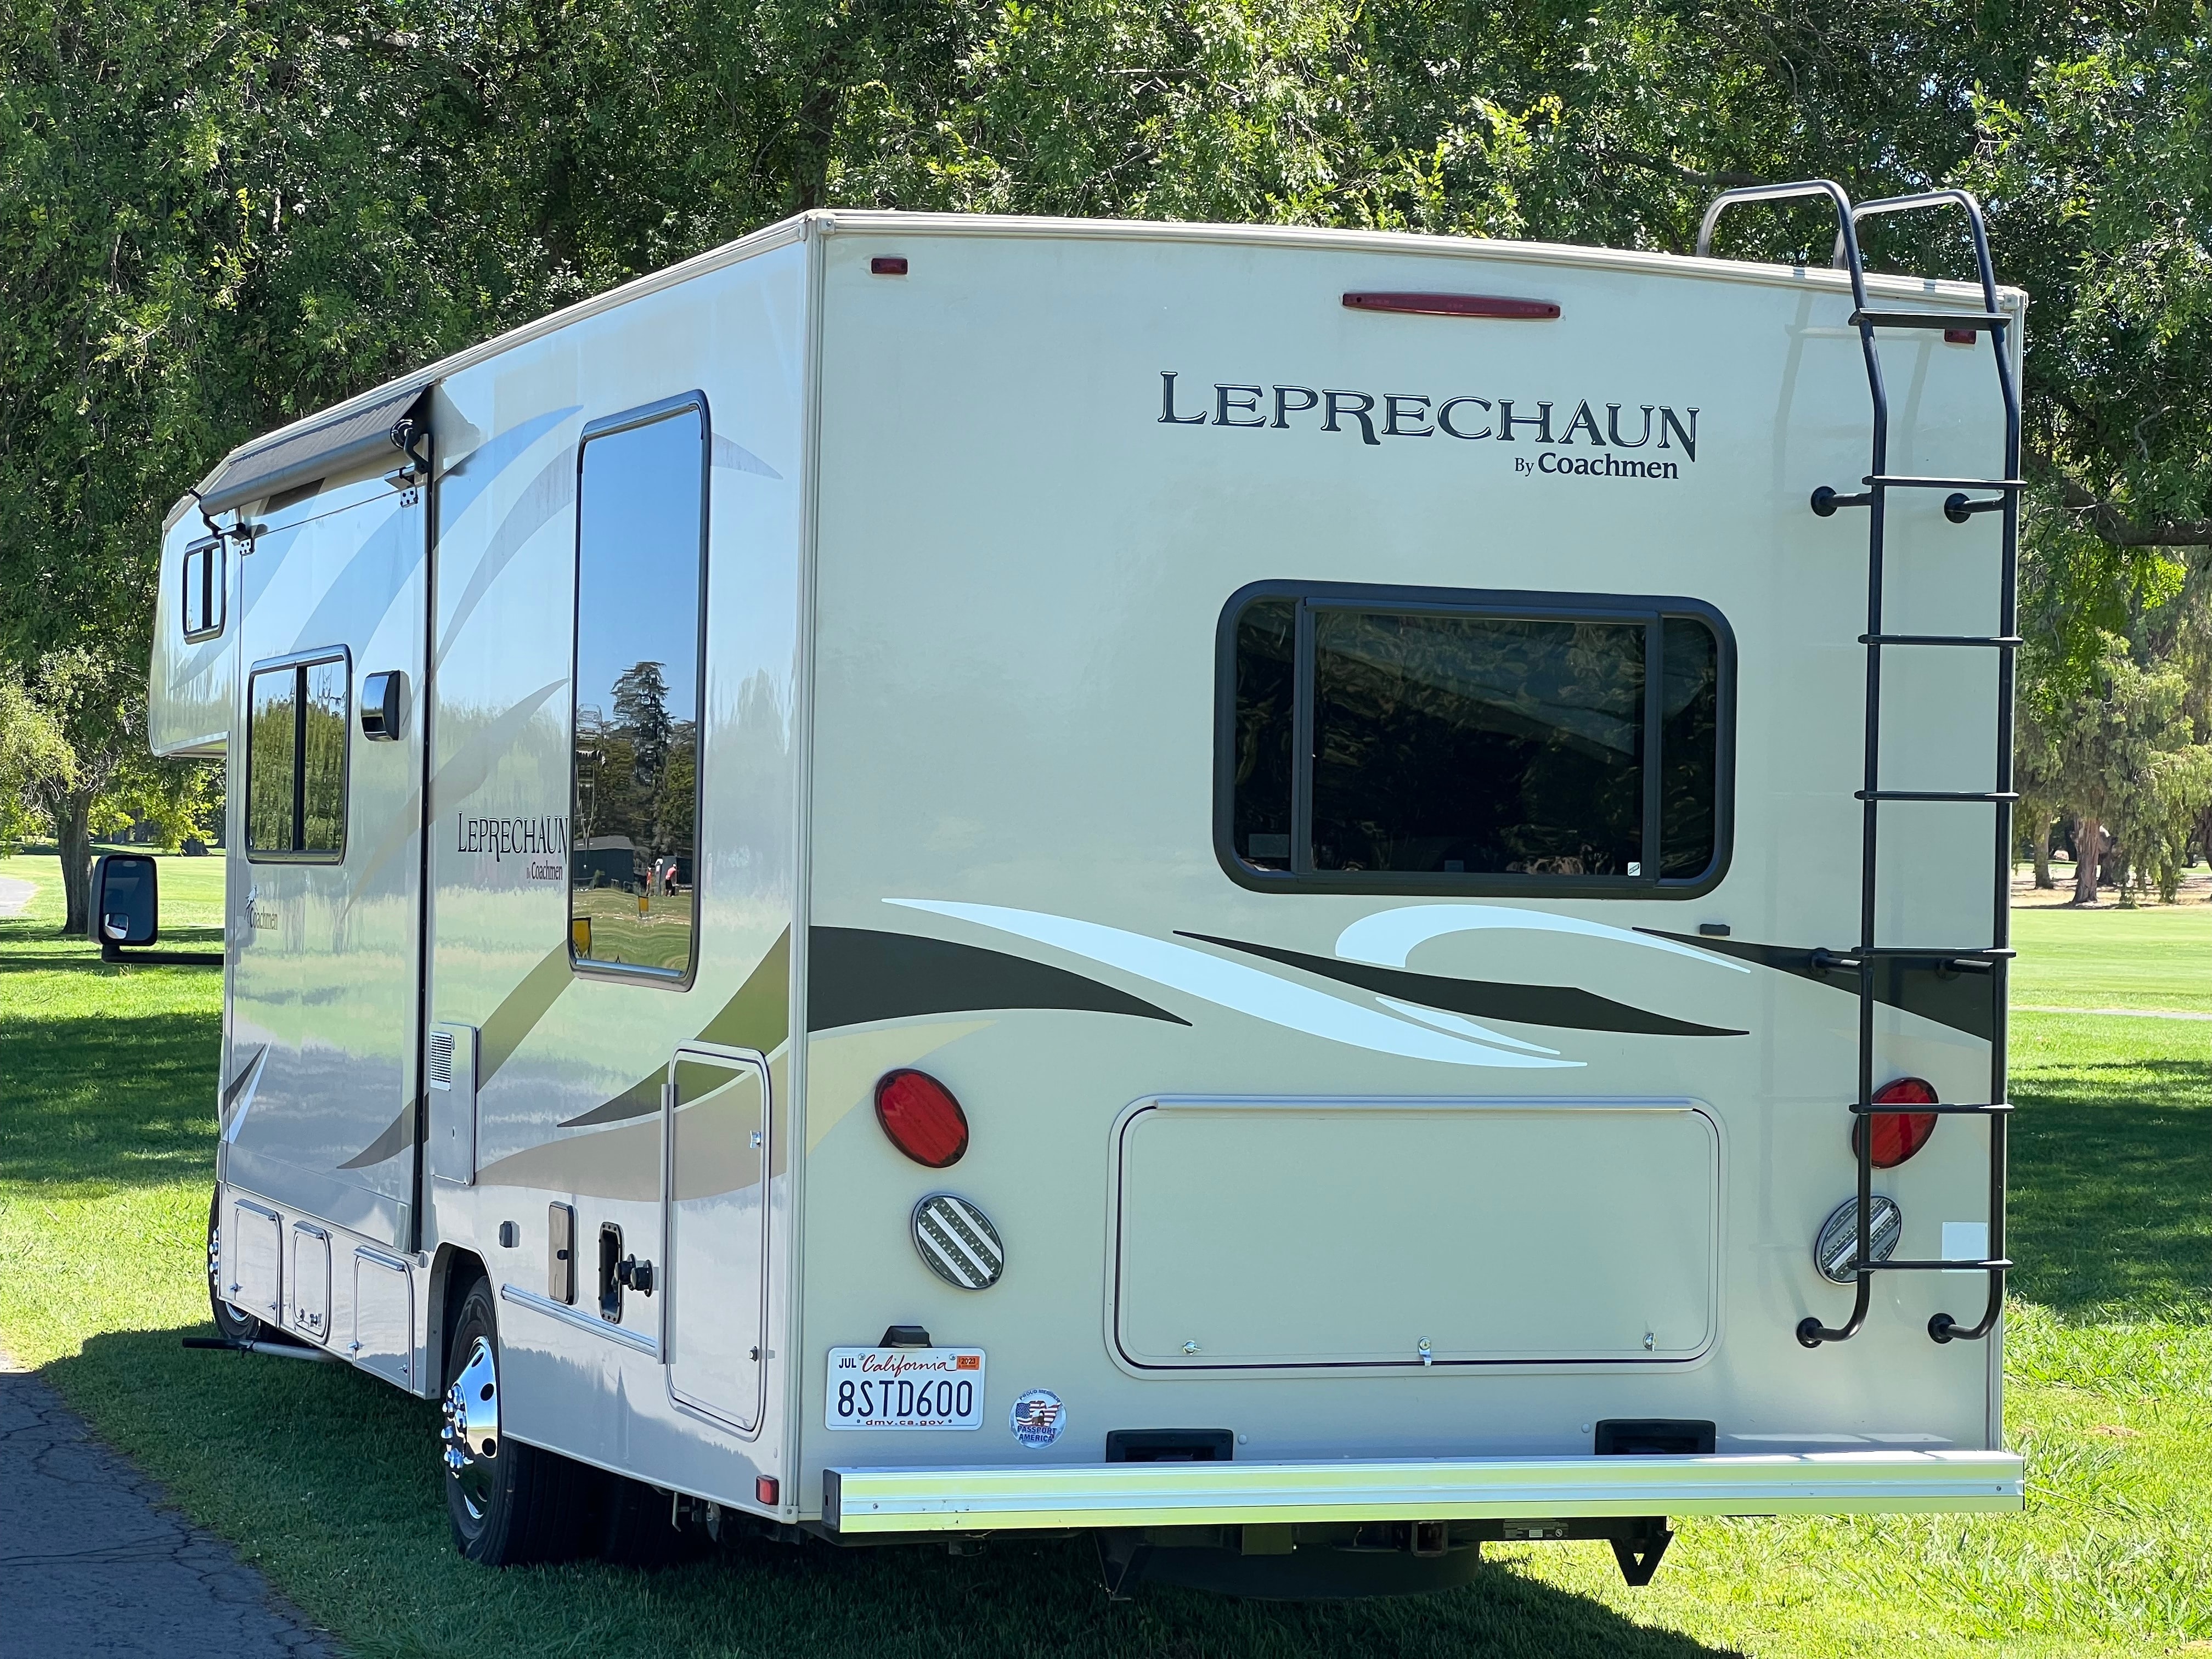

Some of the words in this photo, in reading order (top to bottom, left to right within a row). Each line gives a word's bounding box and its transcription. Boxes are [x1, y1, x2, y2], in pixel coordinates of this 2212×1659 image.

[1157, 370, 1700, 464] LEPRECHAUN
[1515, 457, 1534, 477] By
[1538, 452, 1679, 479] Coachmen
[458, 810, 569, 865] LEPRECHAUN
[531, 860, 563, 881] Coachmen
[249, 906, 278, 930] Coachmen
[838, 1357, 857, 1369] JUL
[862, 1354, 957, 1378] California
[838, 1380, 973, 1417] 8STD600
[1019, 1389, 1037, 1401] PROUD
[1017, 1425, 1057, 1435] PASSPORT
[1019, 1433, 1053, 1442] AMERICA
